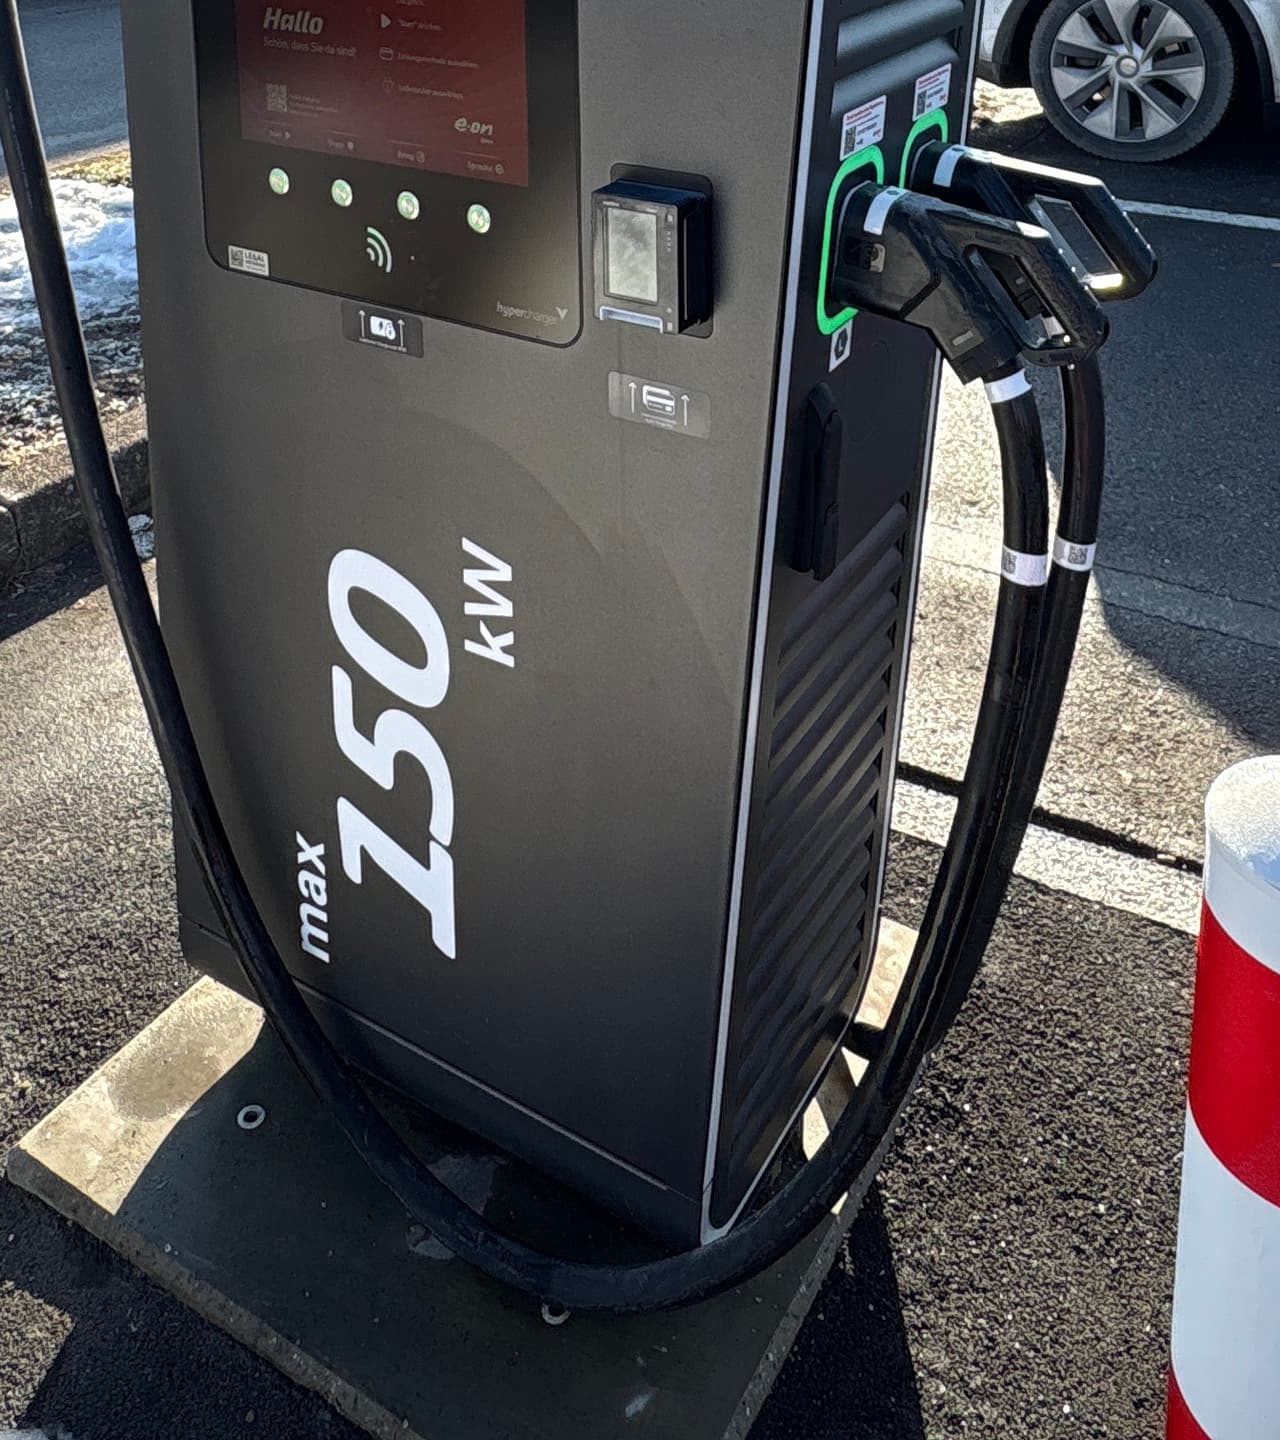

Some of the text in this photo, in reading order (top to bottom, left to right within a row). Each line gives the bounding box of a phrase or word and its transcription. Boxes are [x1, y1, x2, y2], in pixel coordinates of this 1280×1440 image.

[263, 6, 324, 35] Hallo
[496, 301, 558, 327] hypercharger
[296, 536, 515, 963] max 150 kW
